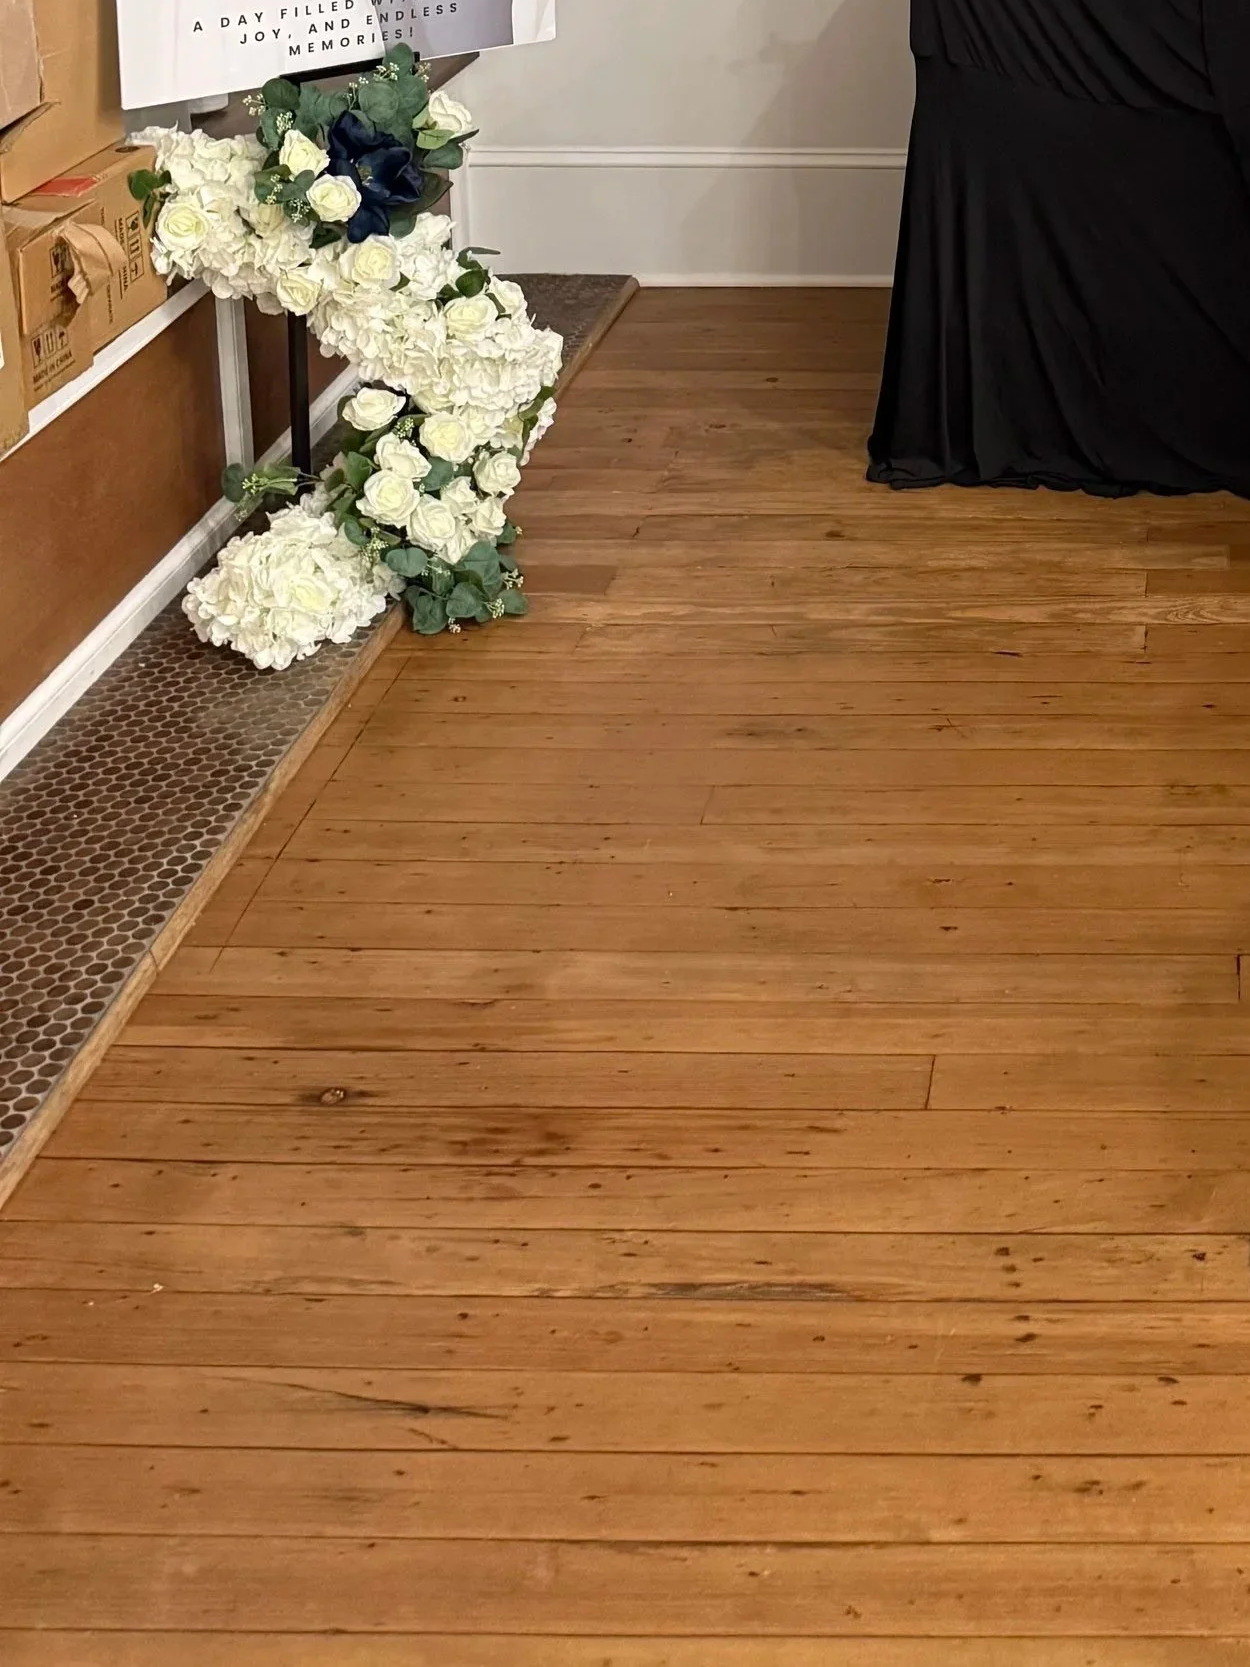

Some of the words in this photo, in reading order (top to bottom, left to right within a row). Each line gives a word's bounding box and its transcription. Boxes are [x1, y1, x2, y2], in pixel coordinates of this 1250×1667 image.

[193, 20, 203, 32] A
[220, 11, 265, 29] DAY
[239, 28, 292, 45] JOY,
[308, 18, 351, 35] AND
[366, 2, 459, 26] ENDLESS
[288, 26, 414, 57] MEMORIES!
